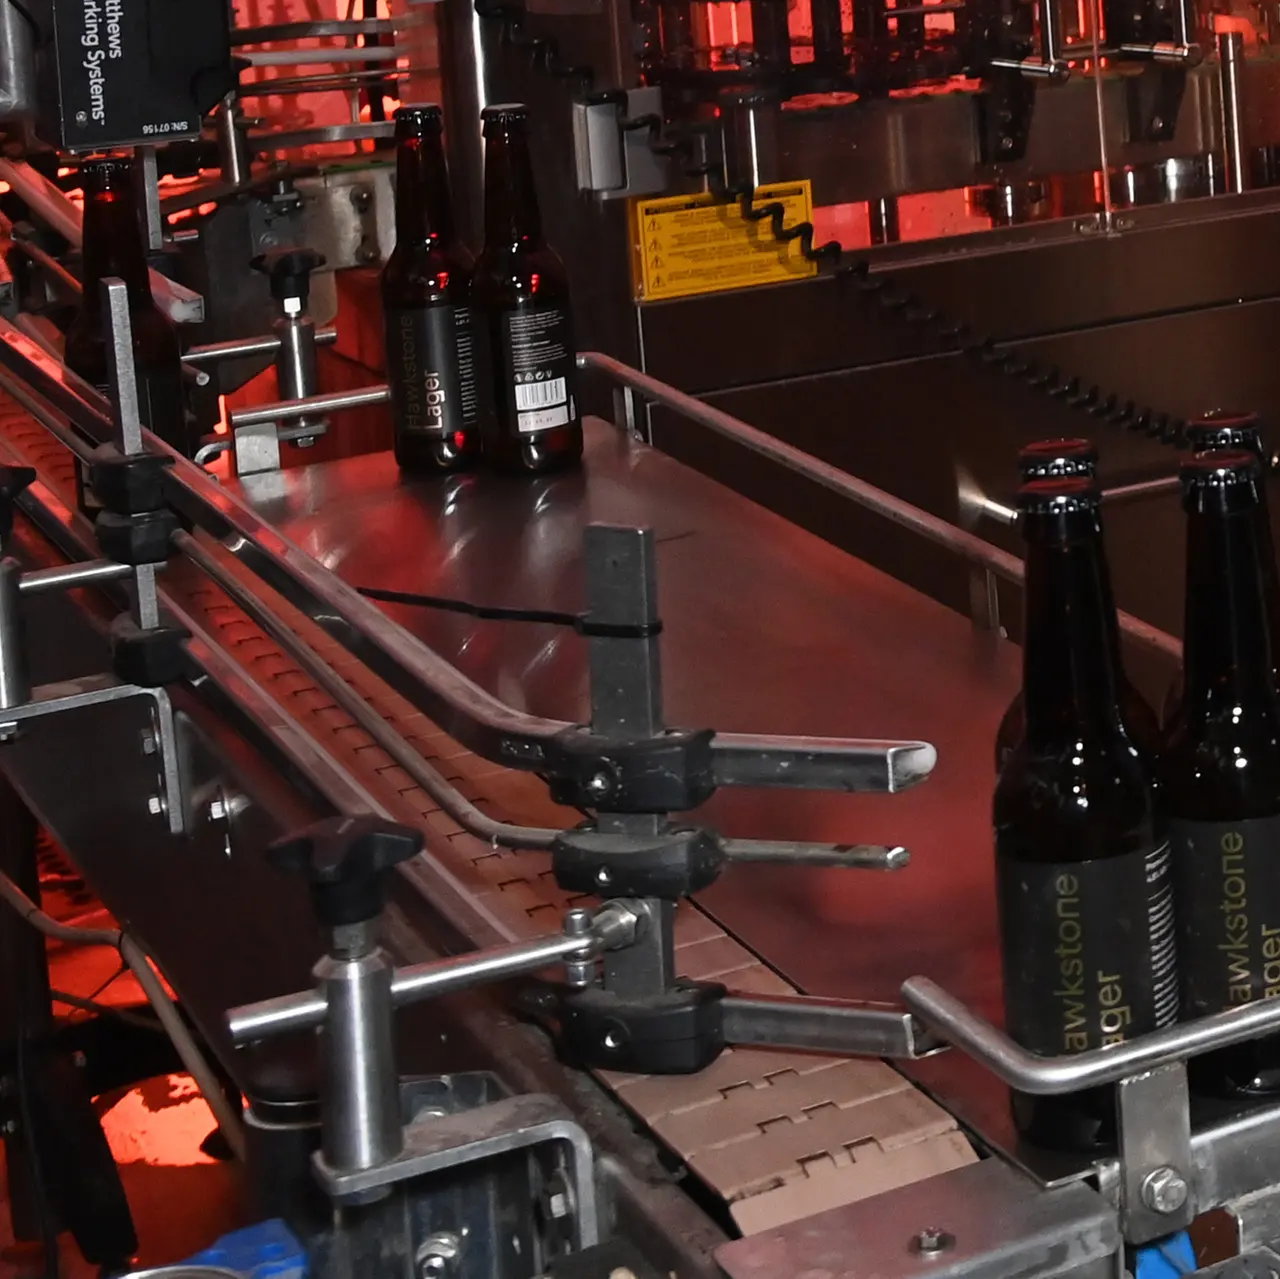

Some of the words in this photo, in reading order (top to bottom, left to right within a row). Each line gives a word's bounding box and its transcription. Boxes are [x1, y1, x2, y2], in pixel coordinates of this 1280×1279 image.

[142, 123, 170, 134] 07156
[400, 317, 421, 430] Hawkstone
[423, 369, 446, 430] Lager
[1053, 873, 1089, 1051] awkstone
[1217, 830, 1252, 1010] awkstone
[1096, 970, 1132, 1050] ager
